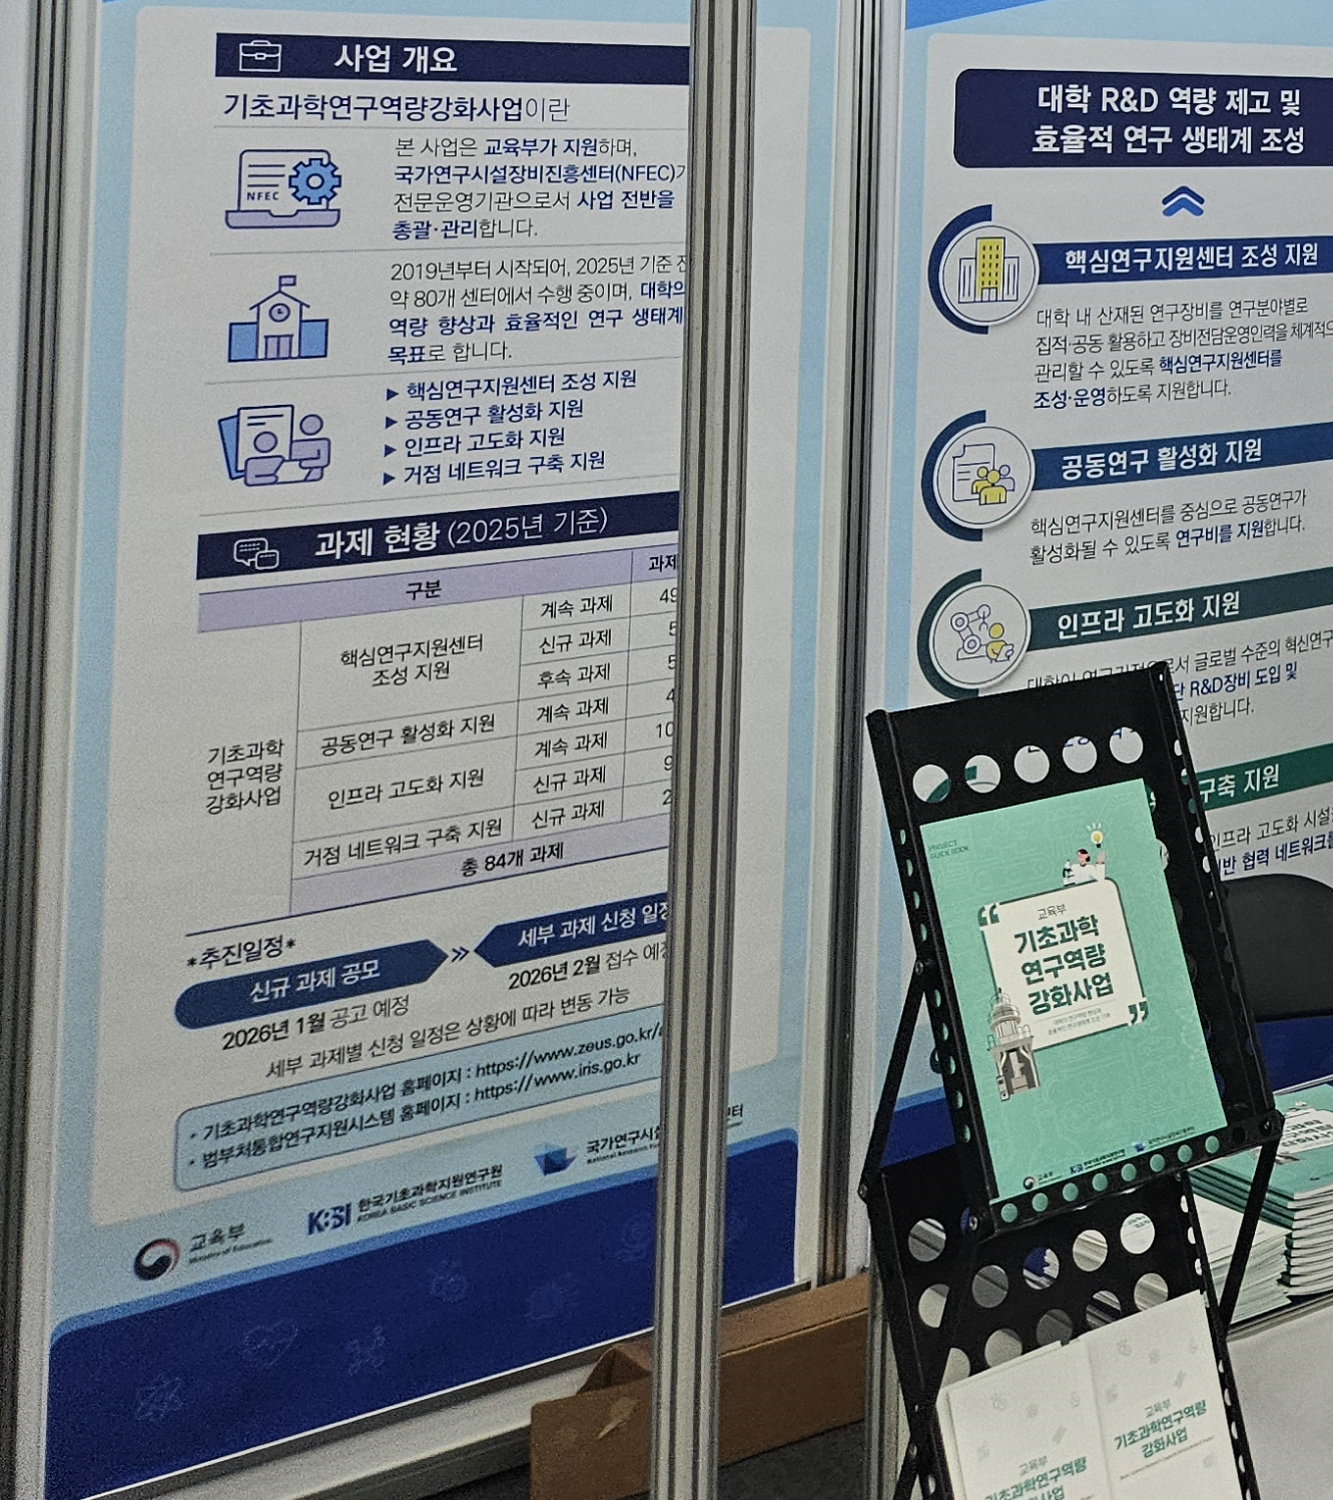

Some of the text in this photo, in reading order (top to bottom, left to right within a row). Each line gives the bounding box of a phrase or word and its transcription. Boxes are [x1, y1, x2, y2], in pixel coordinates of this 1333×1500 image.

[335, 44, 457, 74] 사업 개요
[224, 94, 569, 121] 기초과학연구역량강화사업이란
[1039, 85, 1300, 115] 대학 R&D 역량 제고 및
[396, 138, 636, 157] 본 사업은 교육부가 지원하며,
[1033, 125, 1303, 153] 효율적 연구 생태계 조성
[247, 192, 278, 200] NFEC
[394, 190, 674, 212] 전문운영기관으로서 사업 전반을
[391, 256, 672, 280] 2019년부터 시작되어, 2025년 기준
[1066, 243, 1317, 274] 핵심연구지원센터 조성 지원
[391, 291, 408, 309] 약
[414, 289, 455, 307] 80개
[461, 286, 531, 307] 센터에서
[538, 285, 572, 304] 수행
[390, 307, 682, 337] 역량 향상과 효율적인 연구 생태계
[1037, 309, 1070, 328] 대학
[1098, 305, 1143, 325] 산재된
[388, 341, 511, 365] 목표로 합니다.
[1157, 380, 1232, 400] 지원합니다.
[405, 451, 604, 485] 거점 네트워크 구축 지원
[315, 507, 610, 559] 과제 현황 (2025년 기준)
[406, 580, 441, 600] 구분
[1058, 591, 1239, 639] 인프라 고도화 지원
[208, 739, 284, 765] 기초과학
[208, 763, 282, 790] 연구역량
[1199, 764, 1278, 803] 구축 지원
[206, 786, 280, 815] 강화사업
[462, 842, 563, 877] 총 84개 과제
[1038, 904, 1066, 920] 교육부
[1014, 915, 1099, 954] 기초과학
[1022, 943, 1106, 985] 연구역량
[250, 960, 380, 1002] 신규 과제 공모
[1029, 973, 1113, 1015] 강화사업
[223, 995, 408, 1050] 2026년 1월 공고 예정
[400, 1093, 460, 1122] 홈페이지
[475, 1054, 640, 1101] https://www.iris.go.kr
[204, 1083, 395, 1140] 기초과학연구역량강화사업
[401, 1068, 461, 1096] 홈페이지
[357, 1164, 503, 1212] 한국기초과학지원연구원
[190, 1223, 244, 1252] 교육부
[1115, 1400, 1206, 1449] 기초과학연구역량
[1142, 1428, 1187, 1458] 강화사업
